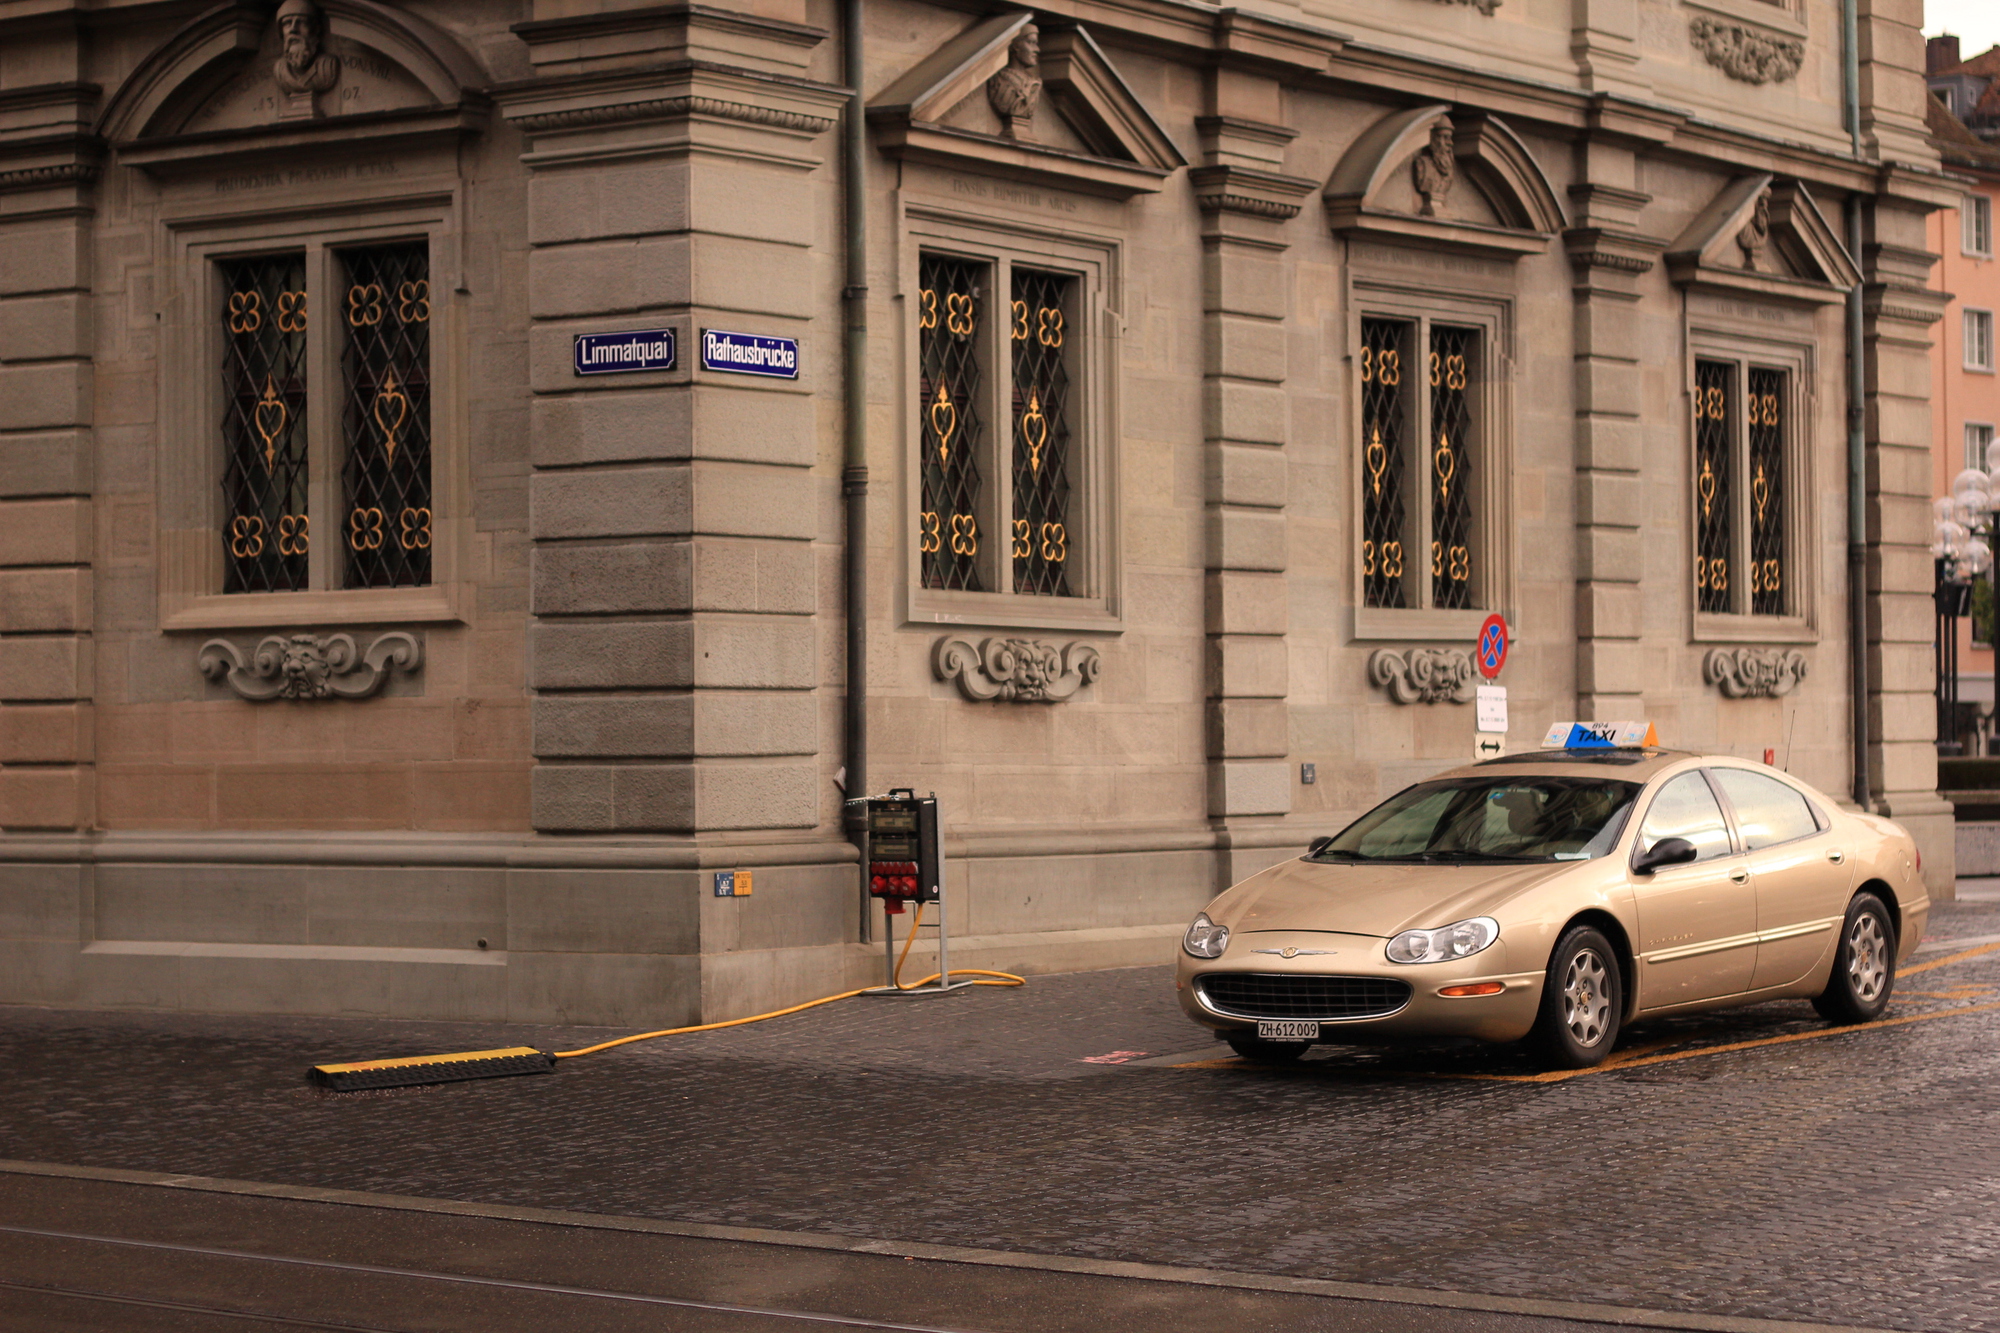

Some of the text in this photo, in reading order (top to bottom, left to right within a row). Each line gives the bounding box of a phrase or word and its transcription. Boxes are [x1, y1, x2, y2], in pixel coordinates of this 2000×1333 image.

[581, 333, 669, 367] Limmatquai
[707, 333, 795, 369] Rathausbrücke
[1577, 729, 1617, 742] TAXI
